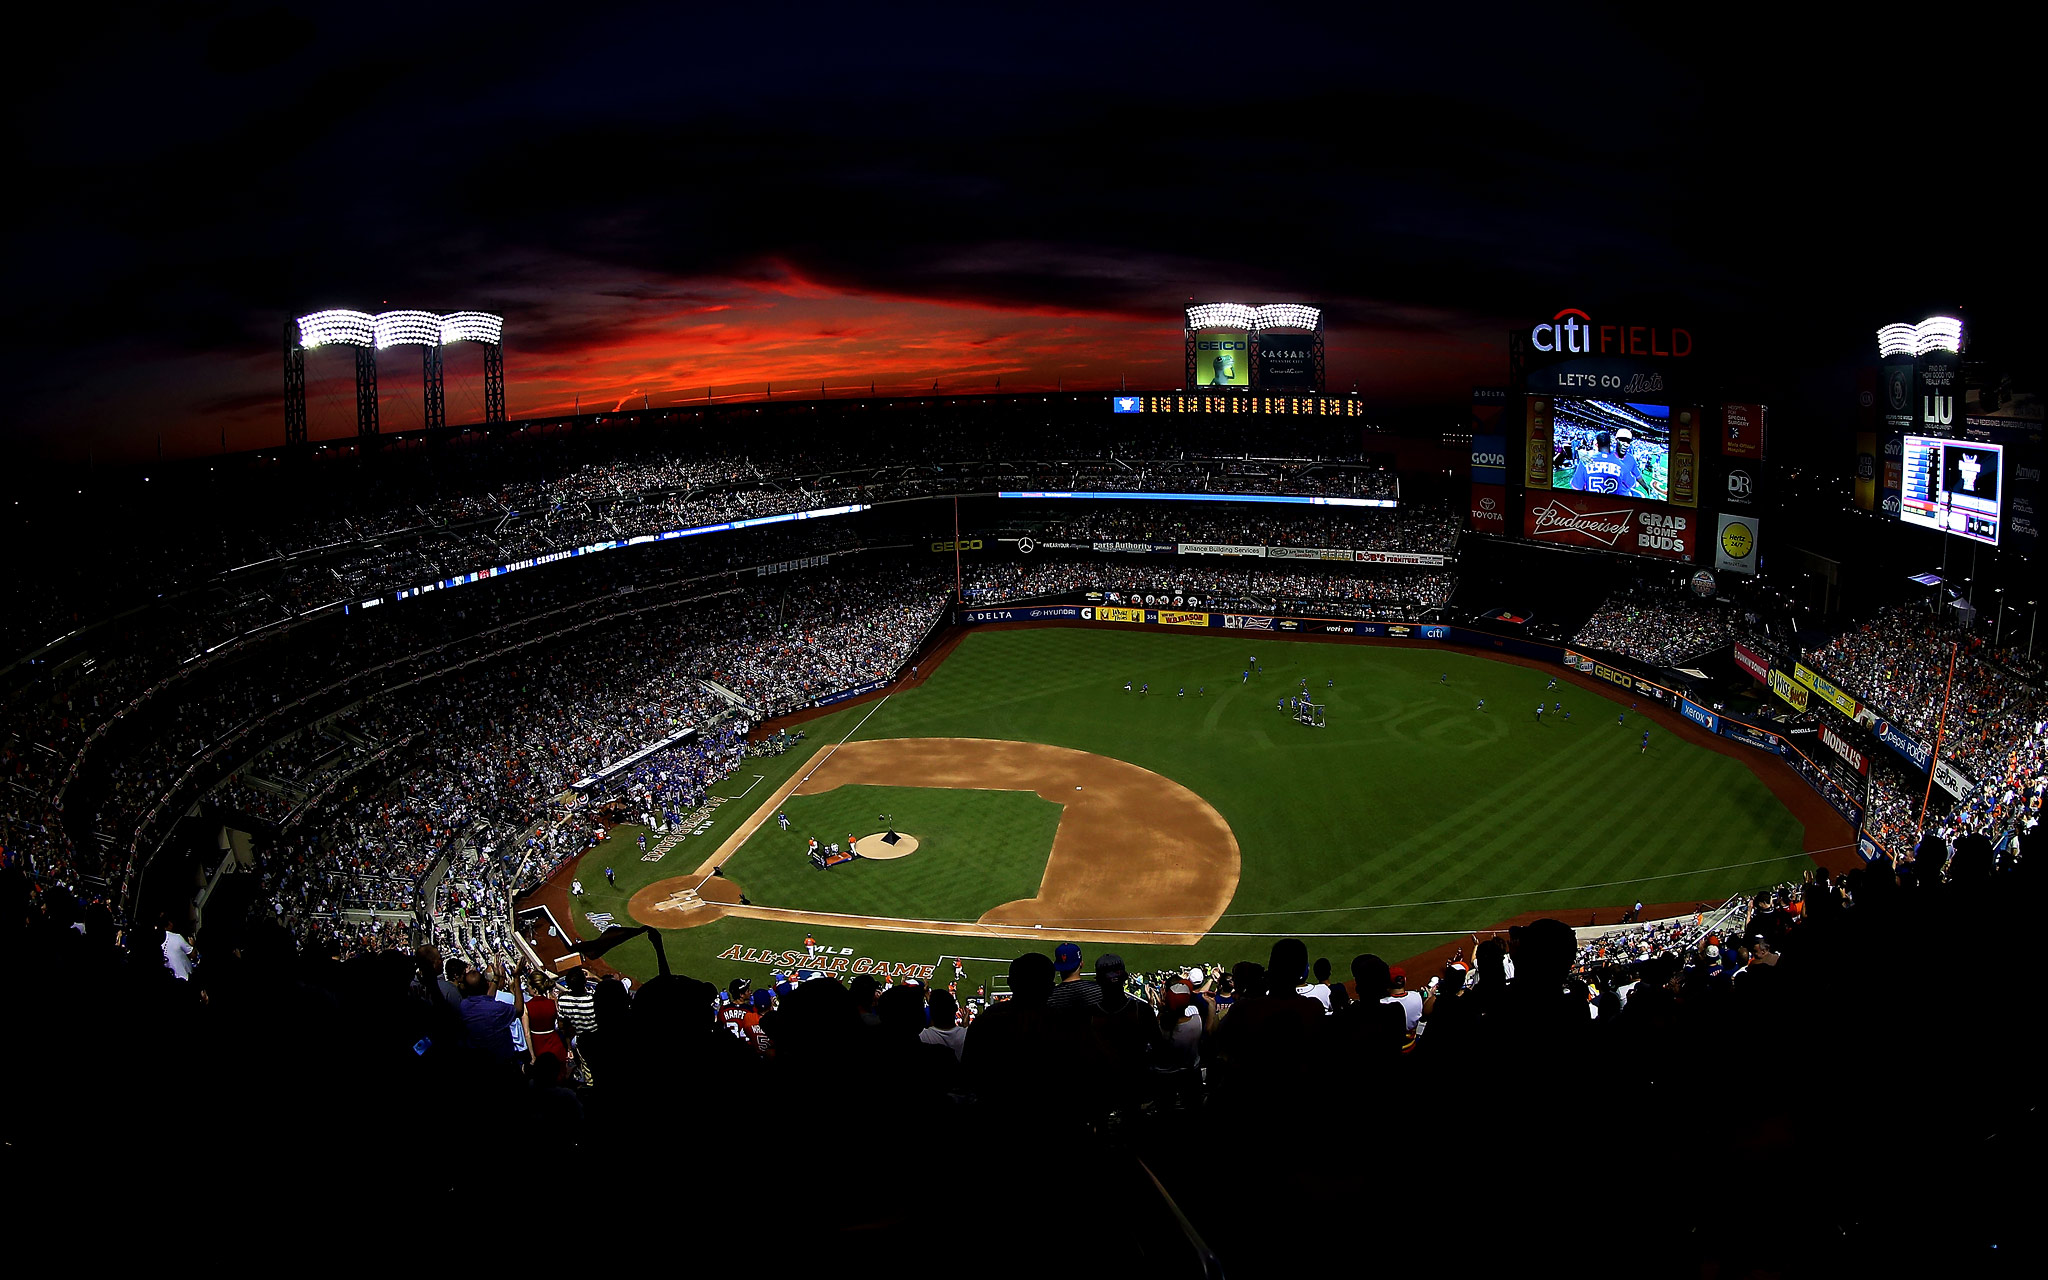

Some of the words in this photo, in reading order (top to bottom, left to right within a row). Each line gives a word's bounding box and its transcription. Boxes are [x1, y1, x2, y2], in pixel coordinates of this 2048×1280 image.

[1532, 316, 1590, 353] citi
[1600, 325, 1692, 357] FIELD
[1198, 341, 1246, 351] GEICO
[1261, 350, 1311, 359] CAESARS
[1945, 371, 1955, 379] YOU
[1558, 373, 1596, 388] LET'S
[1600, 376, 1621, 389] GO
[1624, 373, 1664, 394] Mets
[1924, 395, 1953, 425] LIU
[1472, 452, 1505, 465] GOYA
[1589, 476, 1618, 494] 52
[1728, 475, 1752, 494] DR
[1881, 500, 1899, 512] SNY
[1472, 510, 1503, 521] TOYOTA
[1533, 507, 1630, 535] Budweiser
[1638, 512, 1687, 531] GRAB
[1646, 526, 1678, 538] SOME
[1729, 533, 1747, 542] Hertz
[1093, 542, 1113, 551] Parts
[1114, 542, 1152, 552] Authority
[1638, 535, 1685, 552] BUDS
[1730, 541, 1744, 549] 24/7
[1208, 546, 1232, 554] Building
[1357, 552, 1385, 562] BOB'S
[977, 611, 1013, 620] DELTA
[1326, 625, 1354, 634] verizon
[1427, 629, 1443, 638] citi
[1563, 656, 1577, 664] Gulf
[1595, 664, 1632, 688] GEICO
[1776, 673, 1790, 697] WISE
[1684, 705, 1705, 723] xerox
[1888, 732, 1906, 750] pepsi
[1822, 727, 1861, 770] MODELL'S
[814, 945, 854, 955] MLB
[851, 957, 936, 979] GAME
[723, 1009, 747, 1021] HARPE
